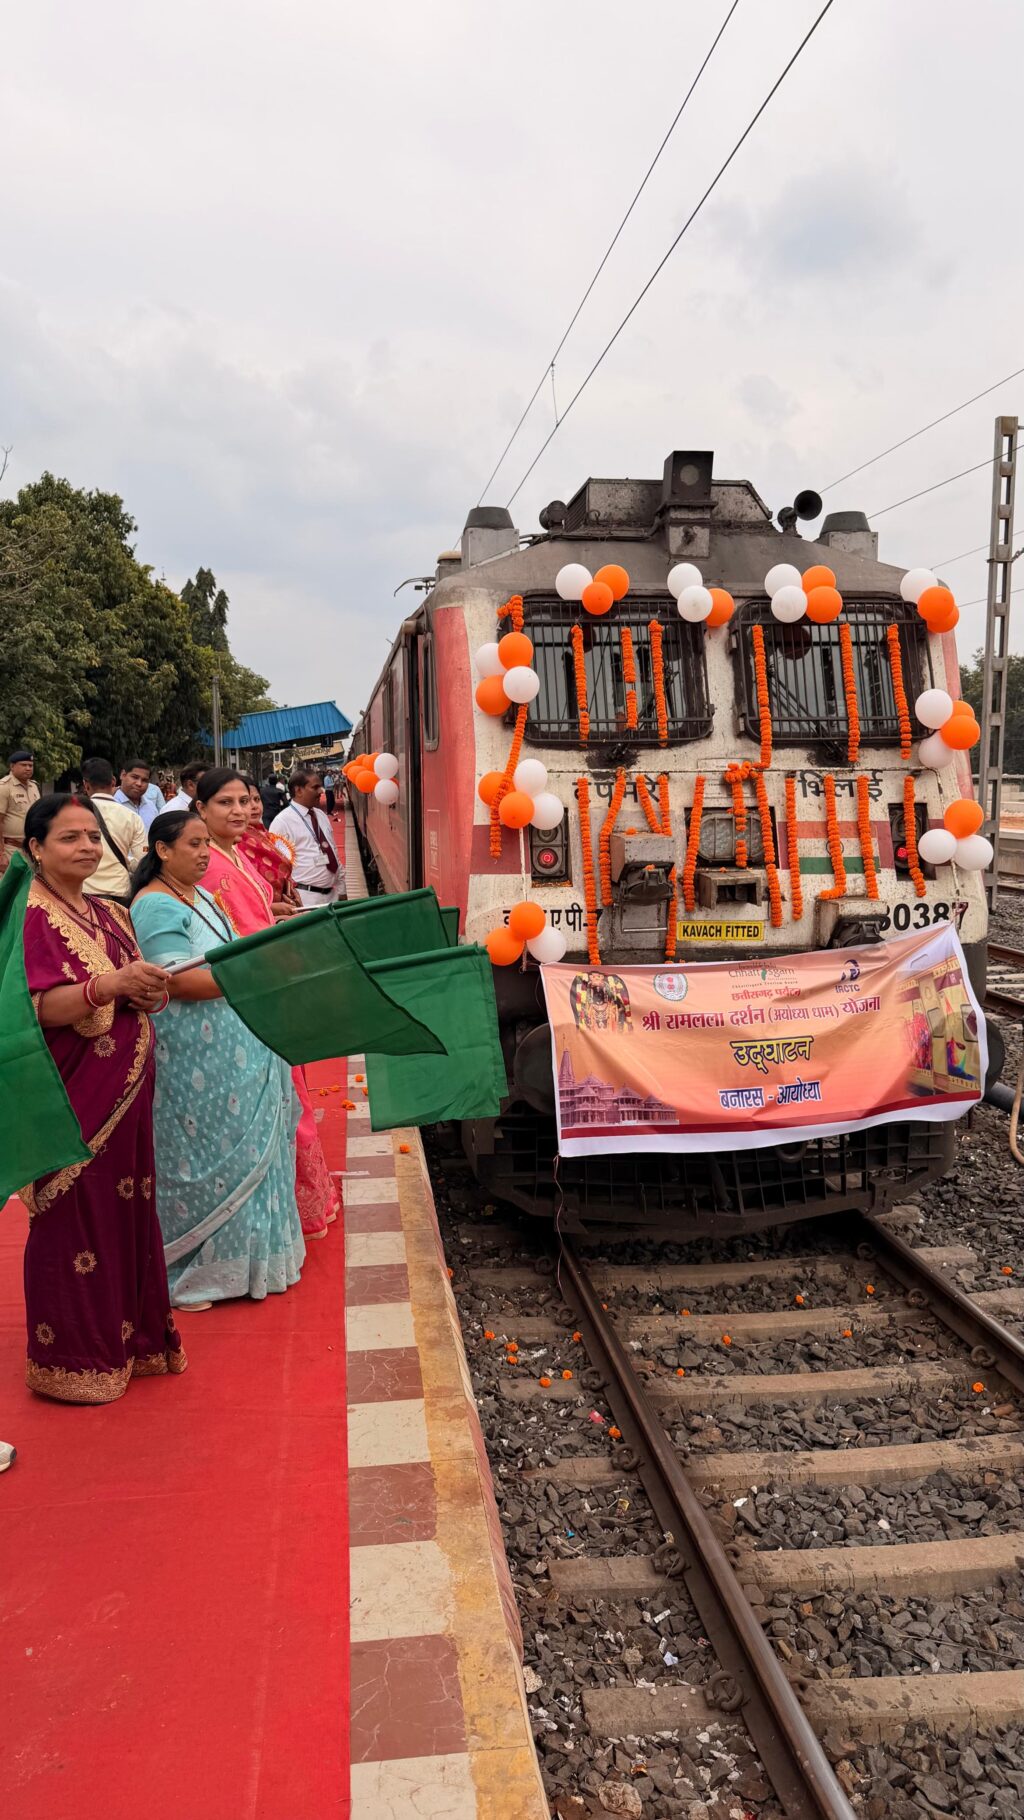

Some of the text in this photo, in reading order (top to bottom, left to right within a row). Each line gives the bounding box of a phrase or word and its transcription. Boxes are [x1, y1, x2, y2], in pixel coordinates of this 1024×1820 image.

[797, 770, 883, 802] भिलई
[682, 925, 759, 937] KAVACH FITTED
[835, 984, 861, 994] IRCTC
[642, 1010, 660, 1031] श्री
[665, 1012, 724, 1030] रामलला
[729, 1004, 765, 1026] दर्शन
[840, 996, 880, 1014] योजना
[729, 1036, 814, 1074] उद्घाटन
[719, 1088, 764, 1108] बनारस
